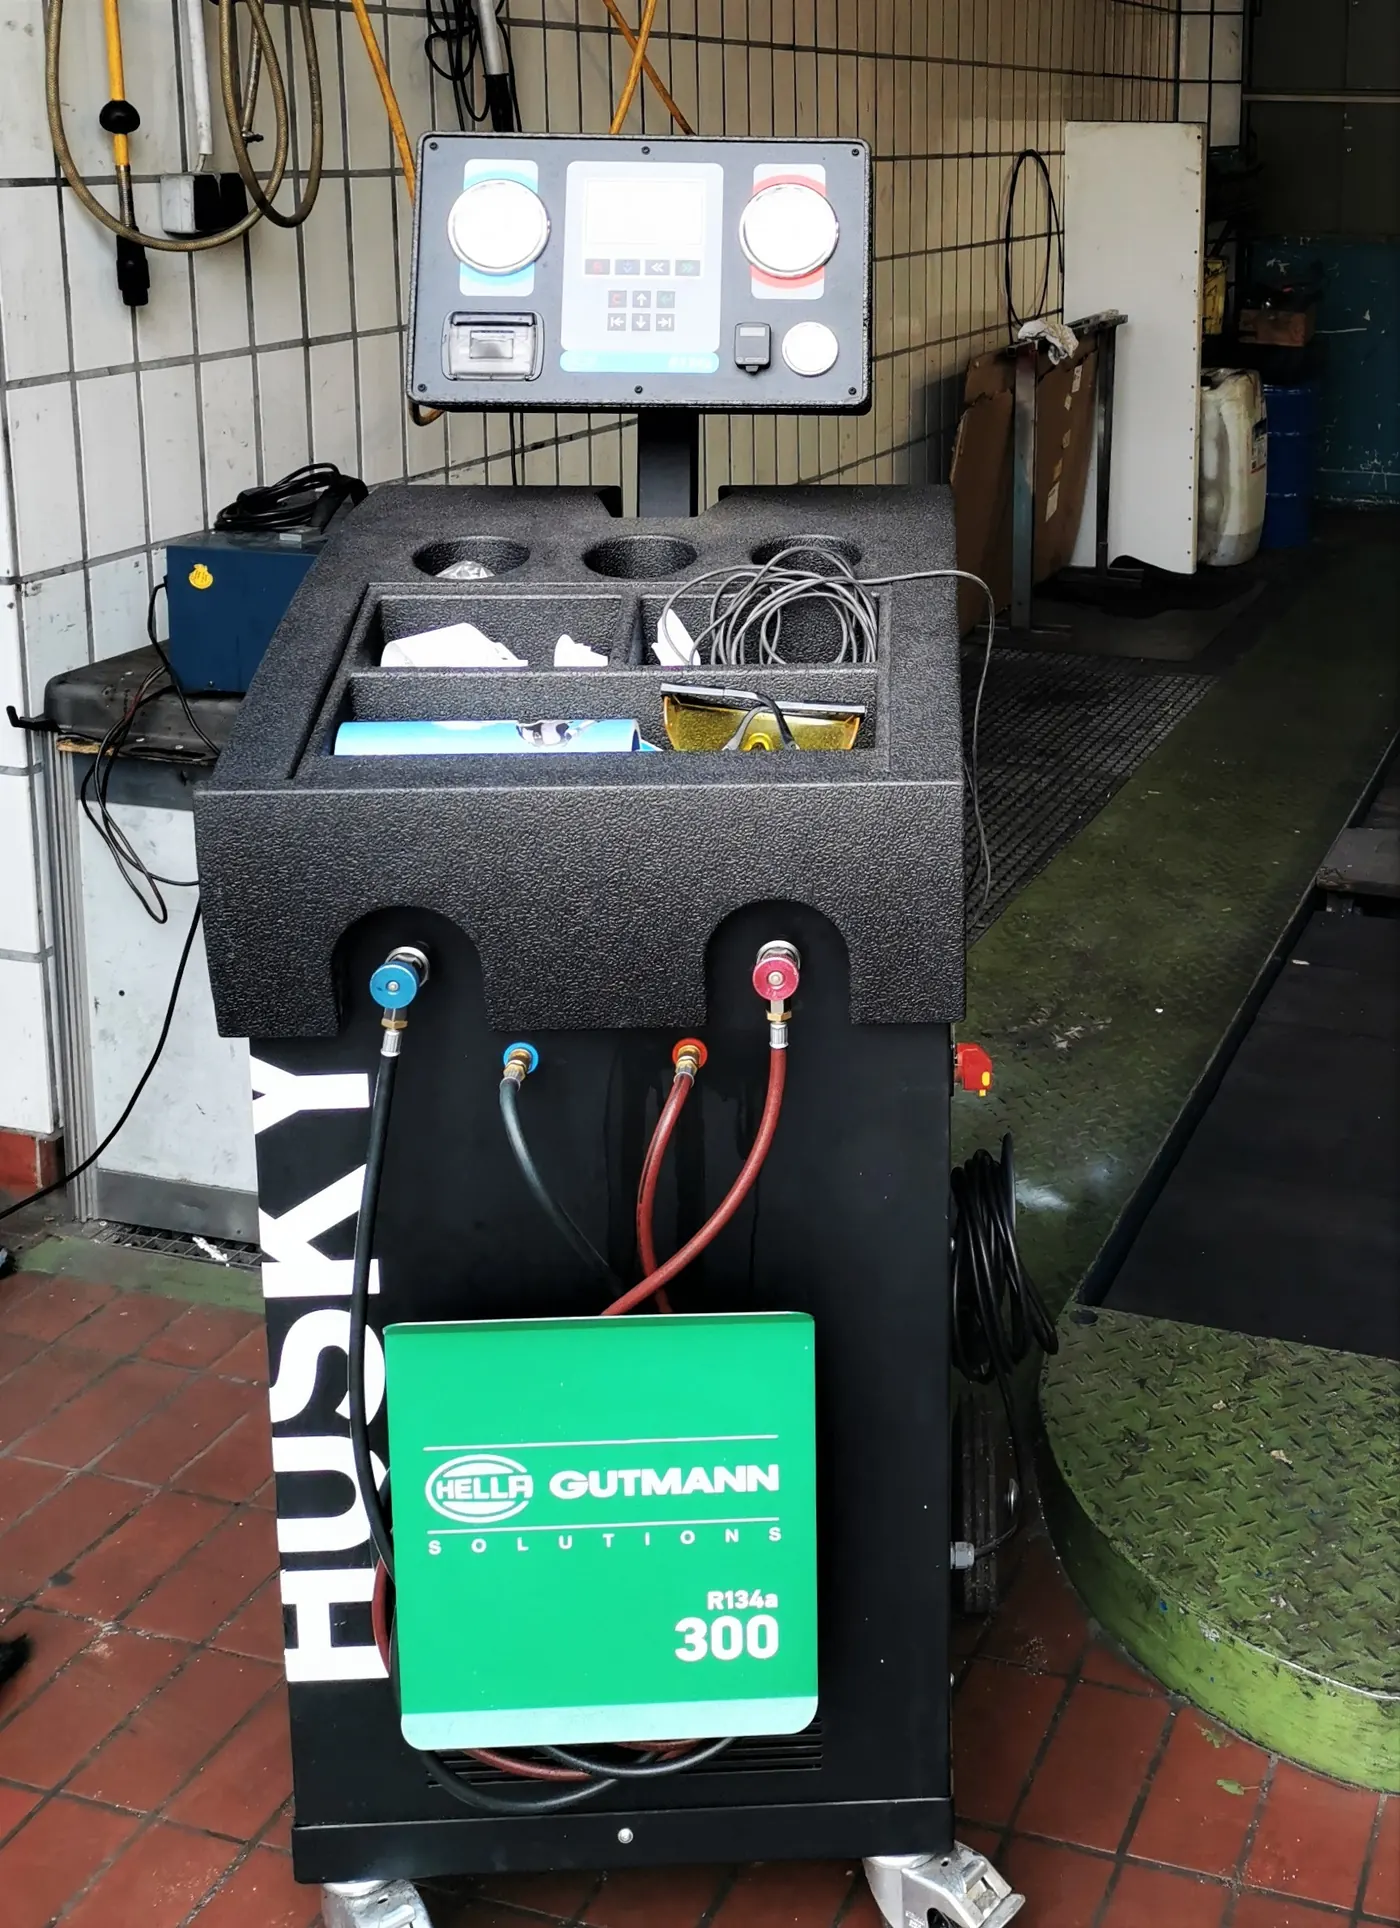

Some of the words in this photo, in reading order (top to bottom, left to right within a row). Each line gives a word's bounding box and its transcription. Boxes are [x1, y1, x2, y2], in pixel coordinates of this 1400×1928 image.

[251, 1054, 391, 1683] HUSKY
[435, 1475, 533, 1502] HELLA
[549, 1464, 779, 1499] GUTMANN
[707, 1590, 778, 1610] R134a
[675, 1615, 778, 1662] 300
